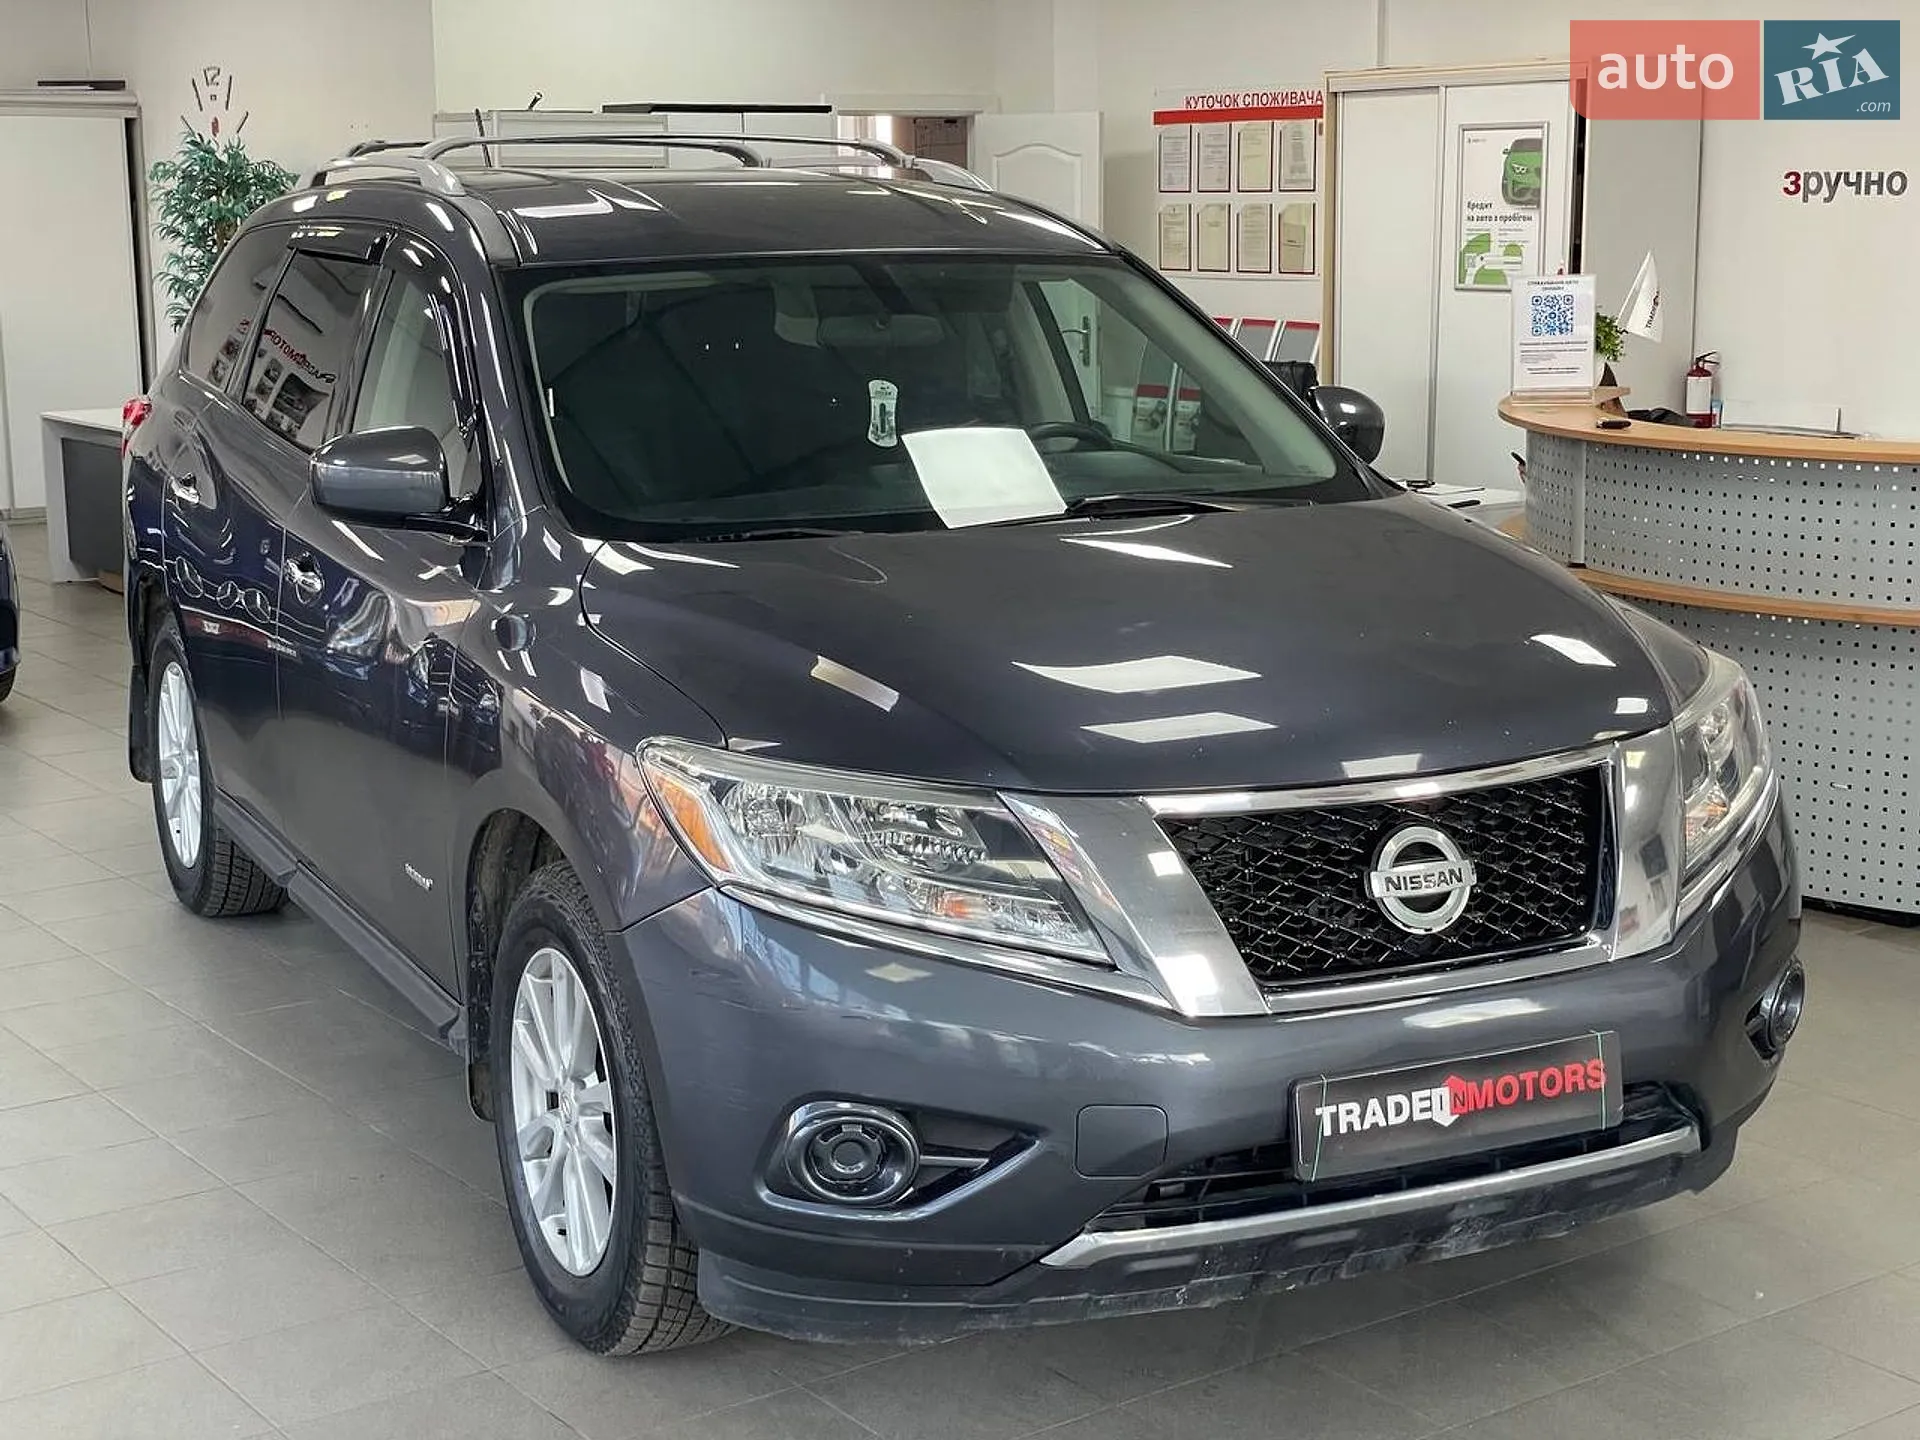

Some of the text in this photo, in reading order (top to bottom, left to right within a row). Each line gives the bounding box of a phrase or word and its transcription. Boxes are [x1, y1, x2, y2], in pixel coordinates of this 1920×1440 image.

[1184, 90, 1324, 110] КУТОЧОК СПОЖИВАЧА
[1783, 169, 1908, 204] зручно
[1466, 200, 1493, 211] Кредит
[1476, 214, 1493, 222] авто
[1499, 212, 1533, 225] пробігом
[1384, 867, 1463, 892] NISSAN
[1315, 1088, 1433, 1137] TRADE
[1466, 1058, 1608, 1117] MOTORS
